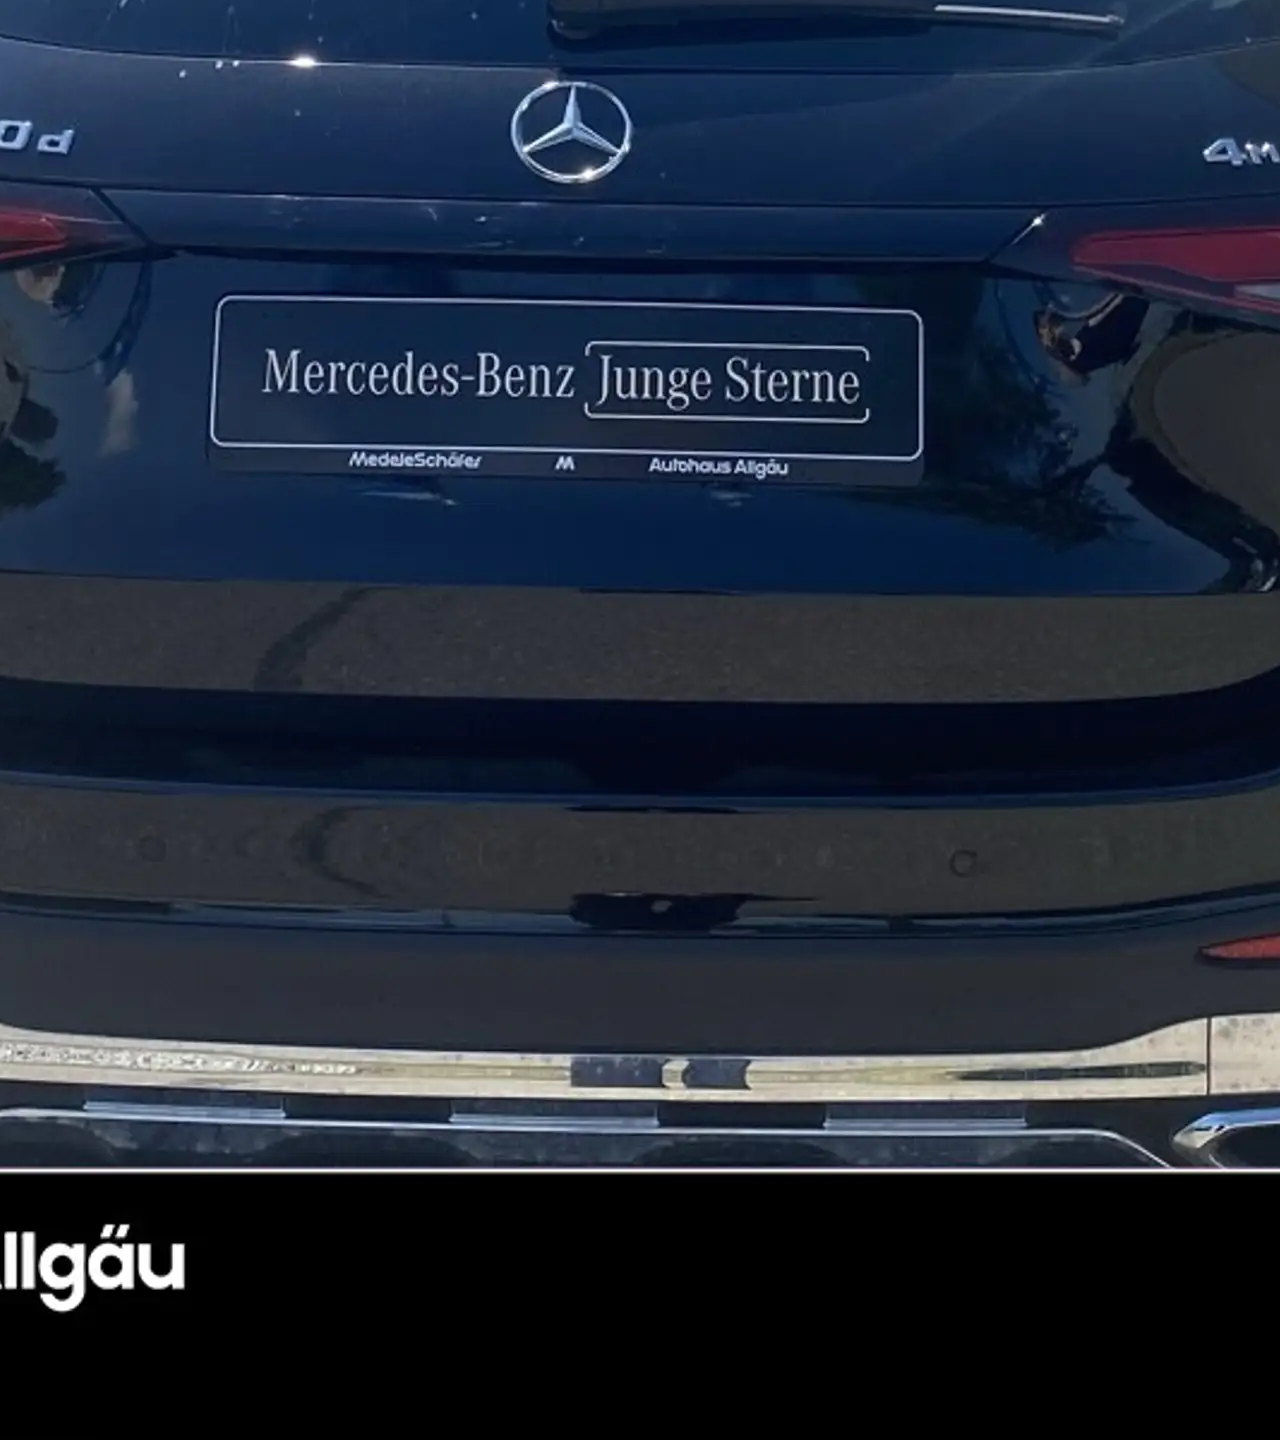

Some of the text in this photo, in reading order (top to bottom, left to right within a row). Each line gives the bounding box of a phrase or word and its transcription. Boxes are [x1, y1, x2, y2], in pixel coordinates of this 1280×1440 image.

[261, 348, 861, 410] Mercedes-Benz Junge Sterne
[649, 456, 788, 479] Autohaus Allgäu
